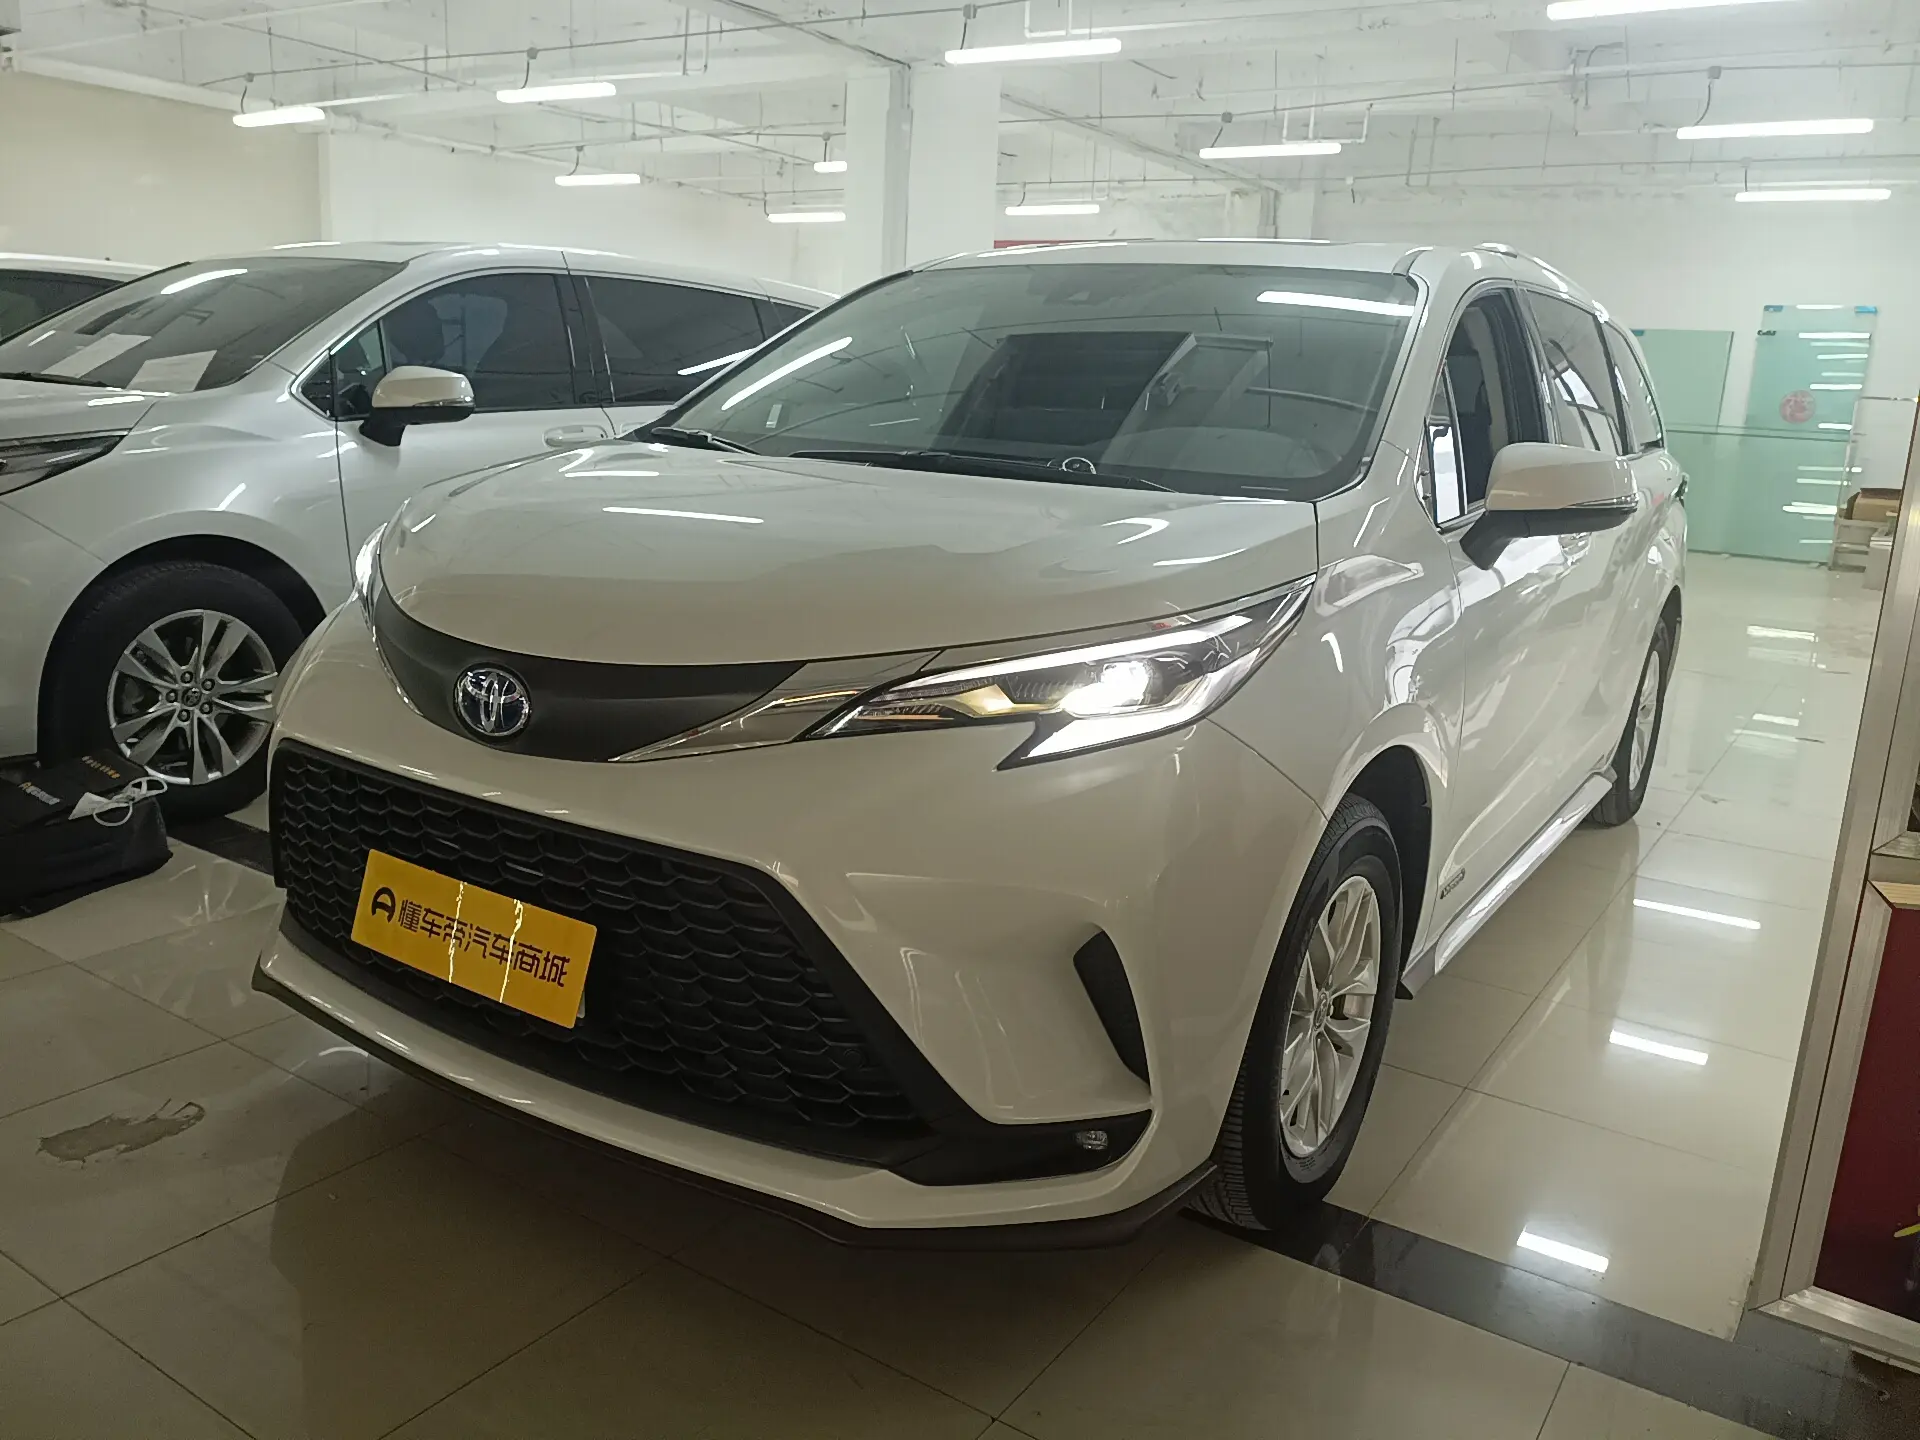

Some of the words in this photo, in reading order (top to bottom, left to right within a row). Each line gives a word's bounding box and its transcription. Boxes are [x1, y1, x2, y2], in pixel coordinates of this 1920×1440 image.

[398, 899, 570, 987] 懂车帝汽车商城
